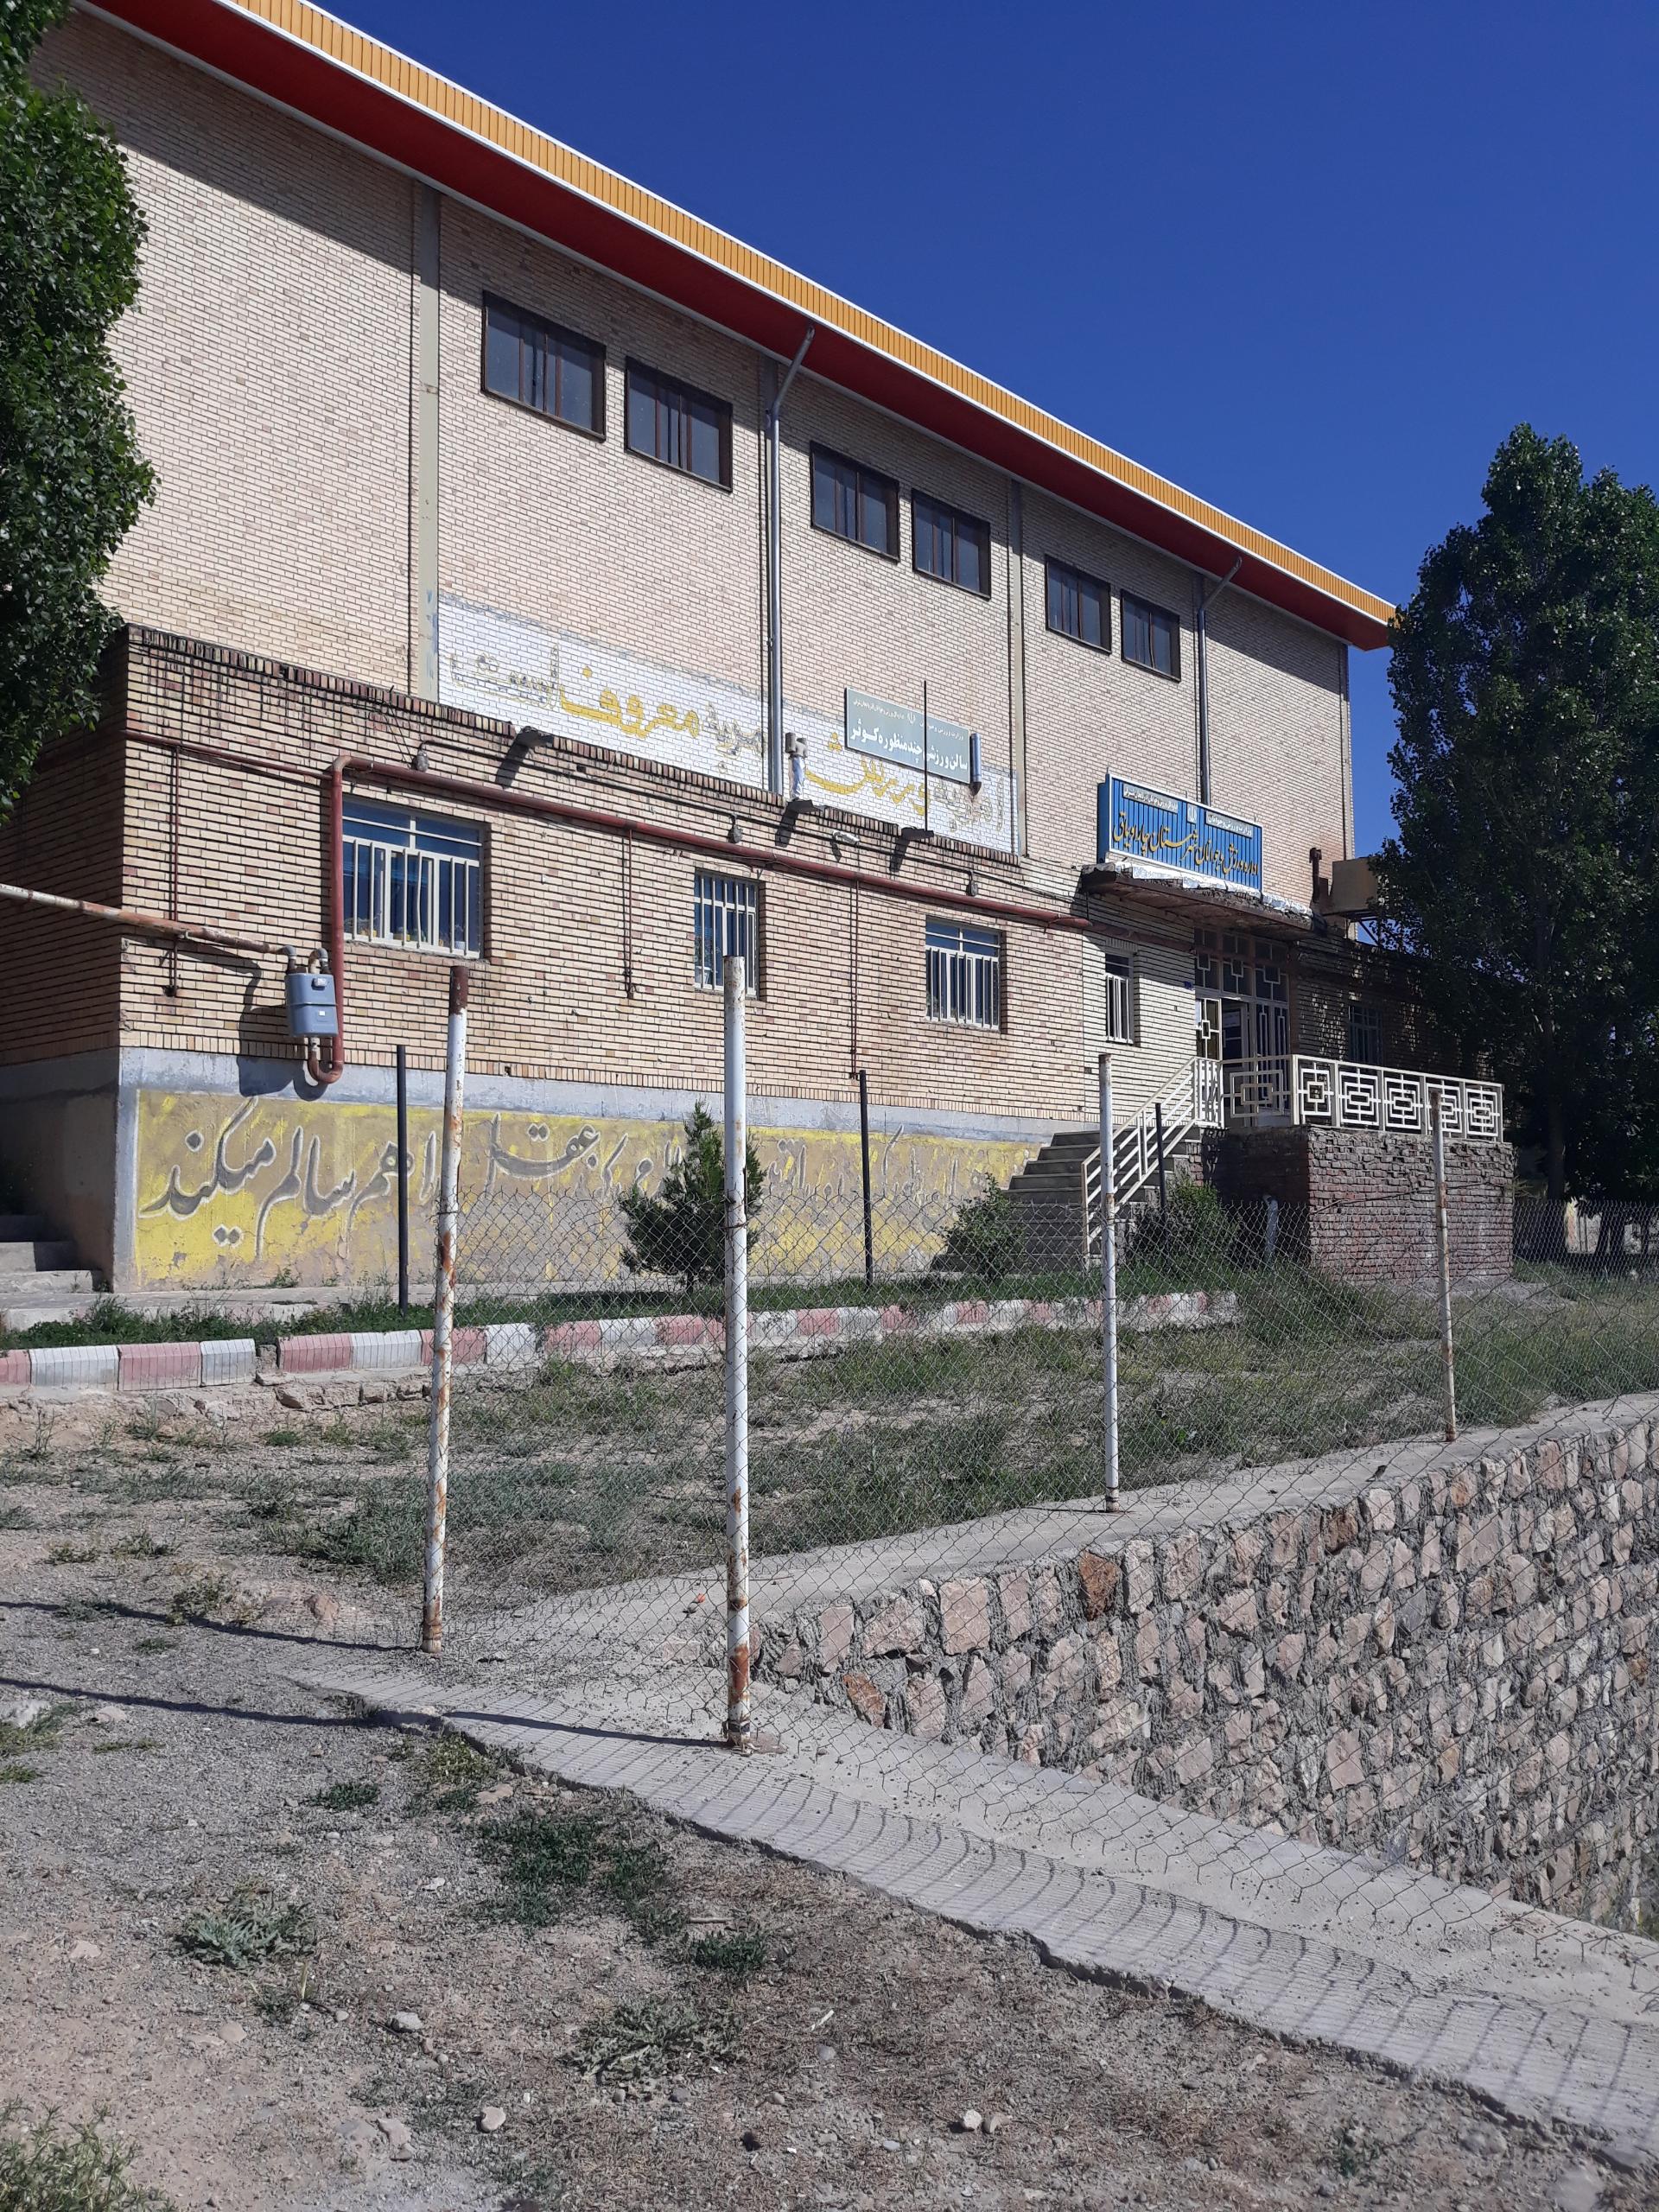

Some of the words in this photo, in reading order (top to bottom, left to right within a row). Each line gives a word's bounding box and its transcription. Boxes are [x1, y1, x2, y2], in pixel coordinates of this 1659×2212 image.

[559, 664, 700, 740] معروف
[850, 718, 880, 743] کوثر
[922, 745, 950, 768] ورزشی
[949, 753, 968, 770] سالن
[1149, 824, 1198, 861] شهرستان
[1238, 825, 1252, 836] وزارت
[1194, 839, 1219, 872] جوانان
[1222, 843, 1243, 874] ورزش
[1243, 860, 1258, 876] اداره
[138, 1096, 276, 1247] میکند
[256, 1125, 357, 1261] سالم
